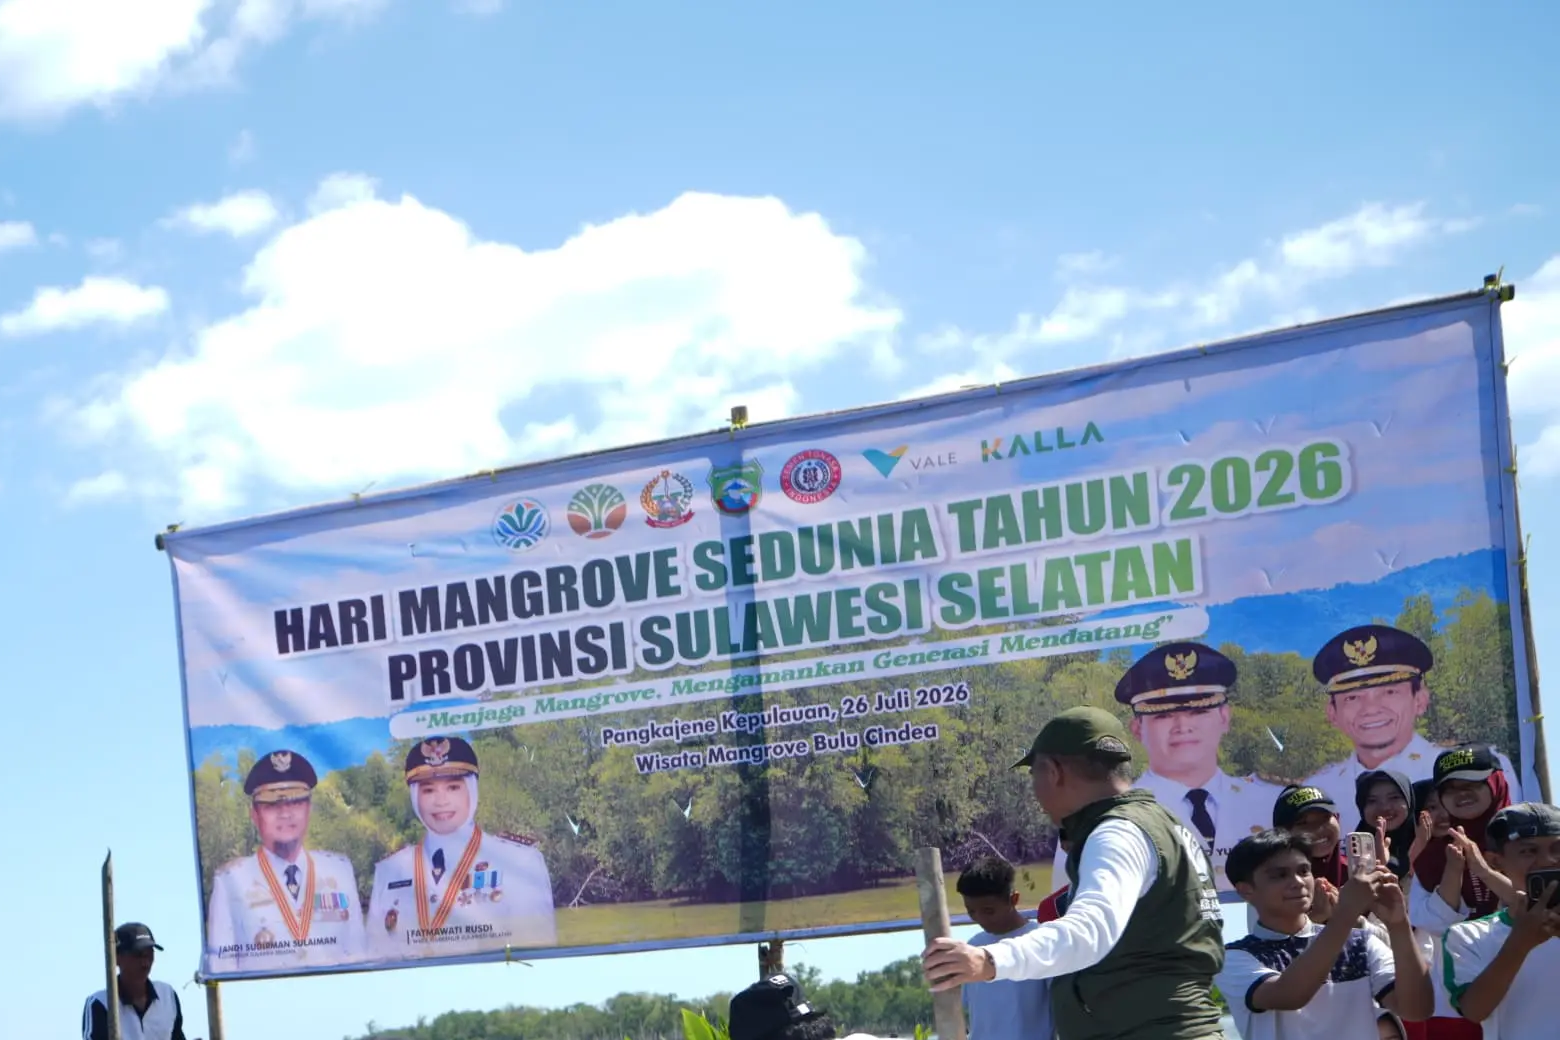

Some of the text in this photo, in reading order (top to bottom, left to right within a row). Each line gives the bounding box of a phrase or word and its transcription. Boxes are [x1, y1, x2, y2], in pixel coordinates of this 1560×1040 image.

[910, 452, 958, 470] VALE
[981, 421, 1105, 464] KALLA
[274, 441, 1343, 655] HARI MANGROVE SEDUNIA TAHUN 2026
[388, 537, 1195, 701] PROVINSI SULAWESI SELATAN
[670, 660, 865, 696] Mengamankan
[873, 641, 989, 670] Generasi
[602, 684, 969, 747] Pangkajene Kepulauan, 26 Juli 2026
[636, 723, 938, 774] Wisata Mangrove Bulu Cindea
[222, 937, 337, 953] ANDI SUDIRMAN SULAIMAN
[411, 924, 493, 938] FATMAWATI RUSDI
